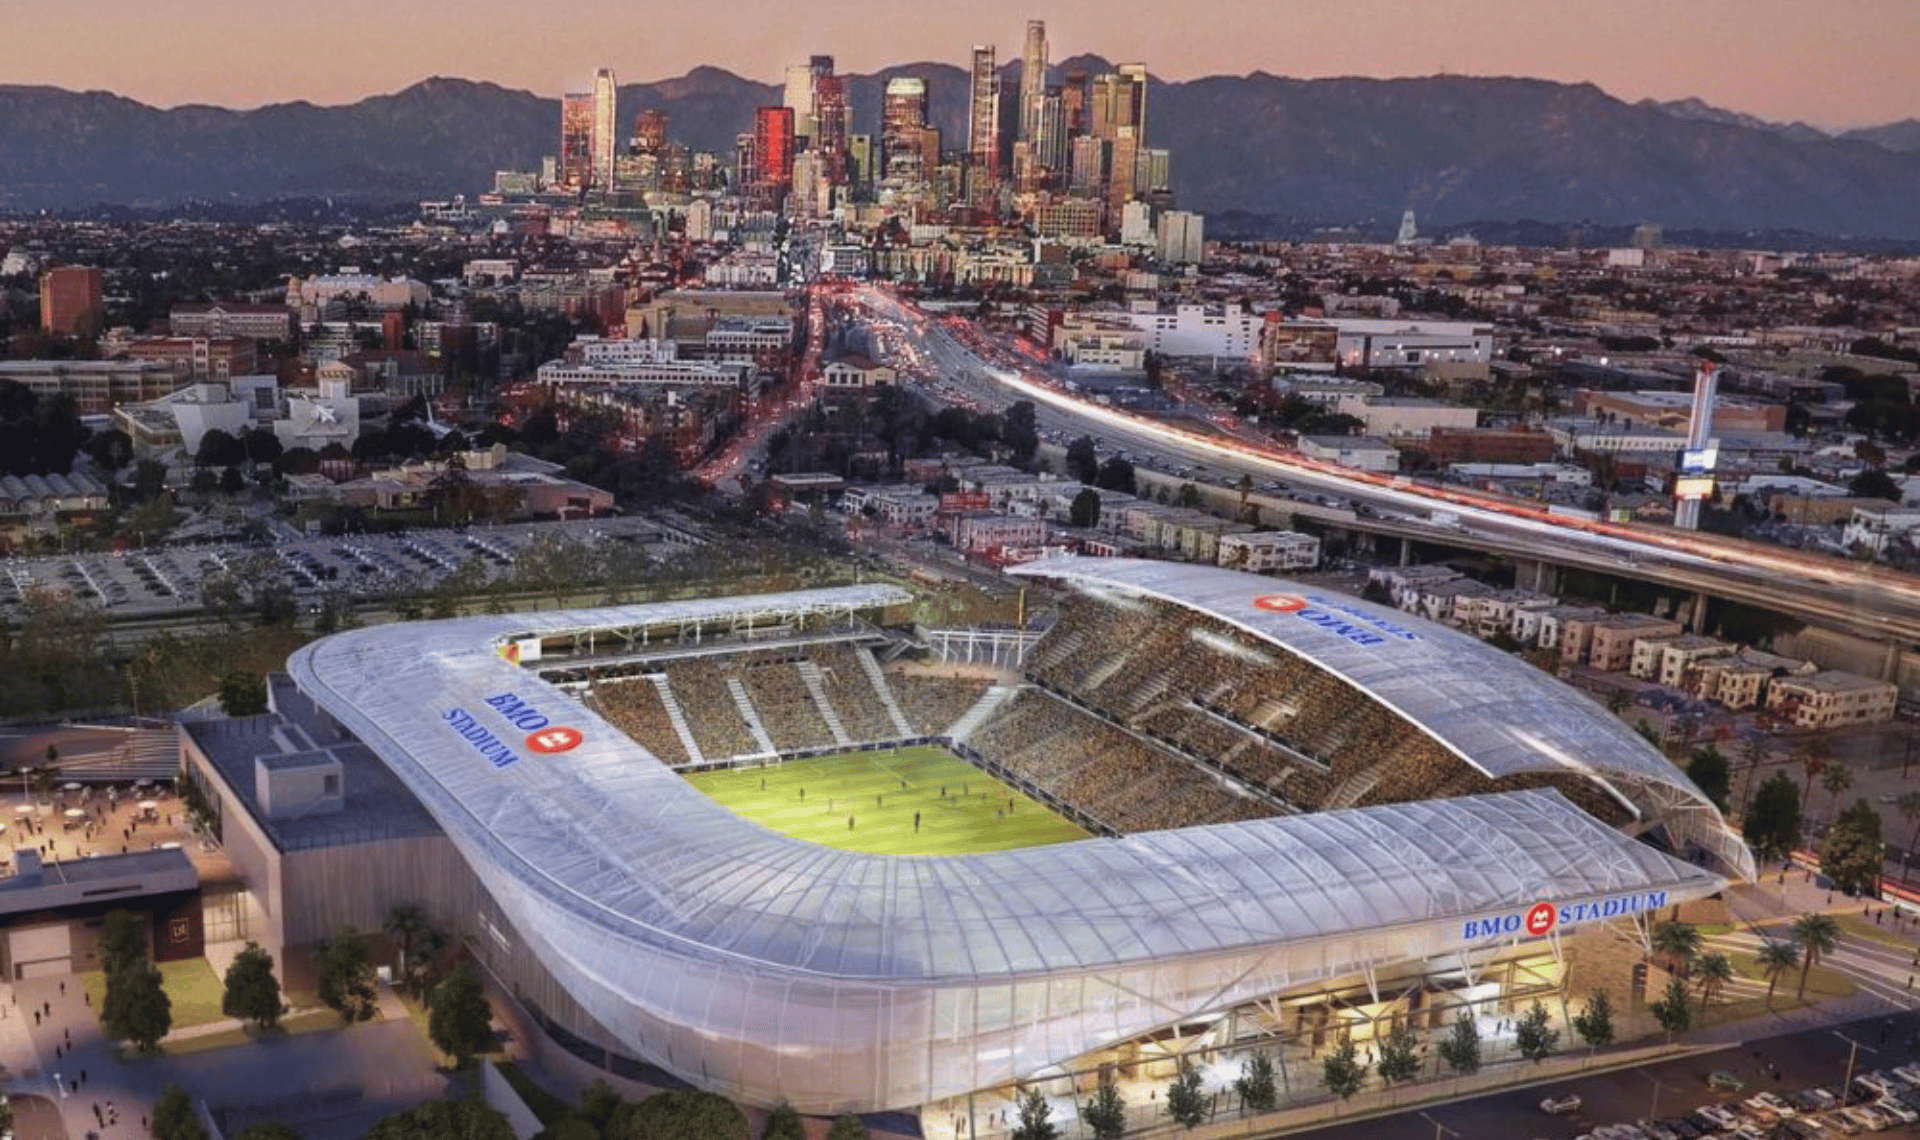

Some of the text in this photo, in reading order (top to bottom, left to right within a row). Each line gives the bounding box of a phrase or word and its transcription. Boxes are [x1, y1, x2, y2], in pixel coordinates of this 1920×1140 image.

[484, 692, 549, 731] BMO
[442, 707, 519, 768] STADIUM
[1463, 891, 1667, 939] BMO STADIUM
